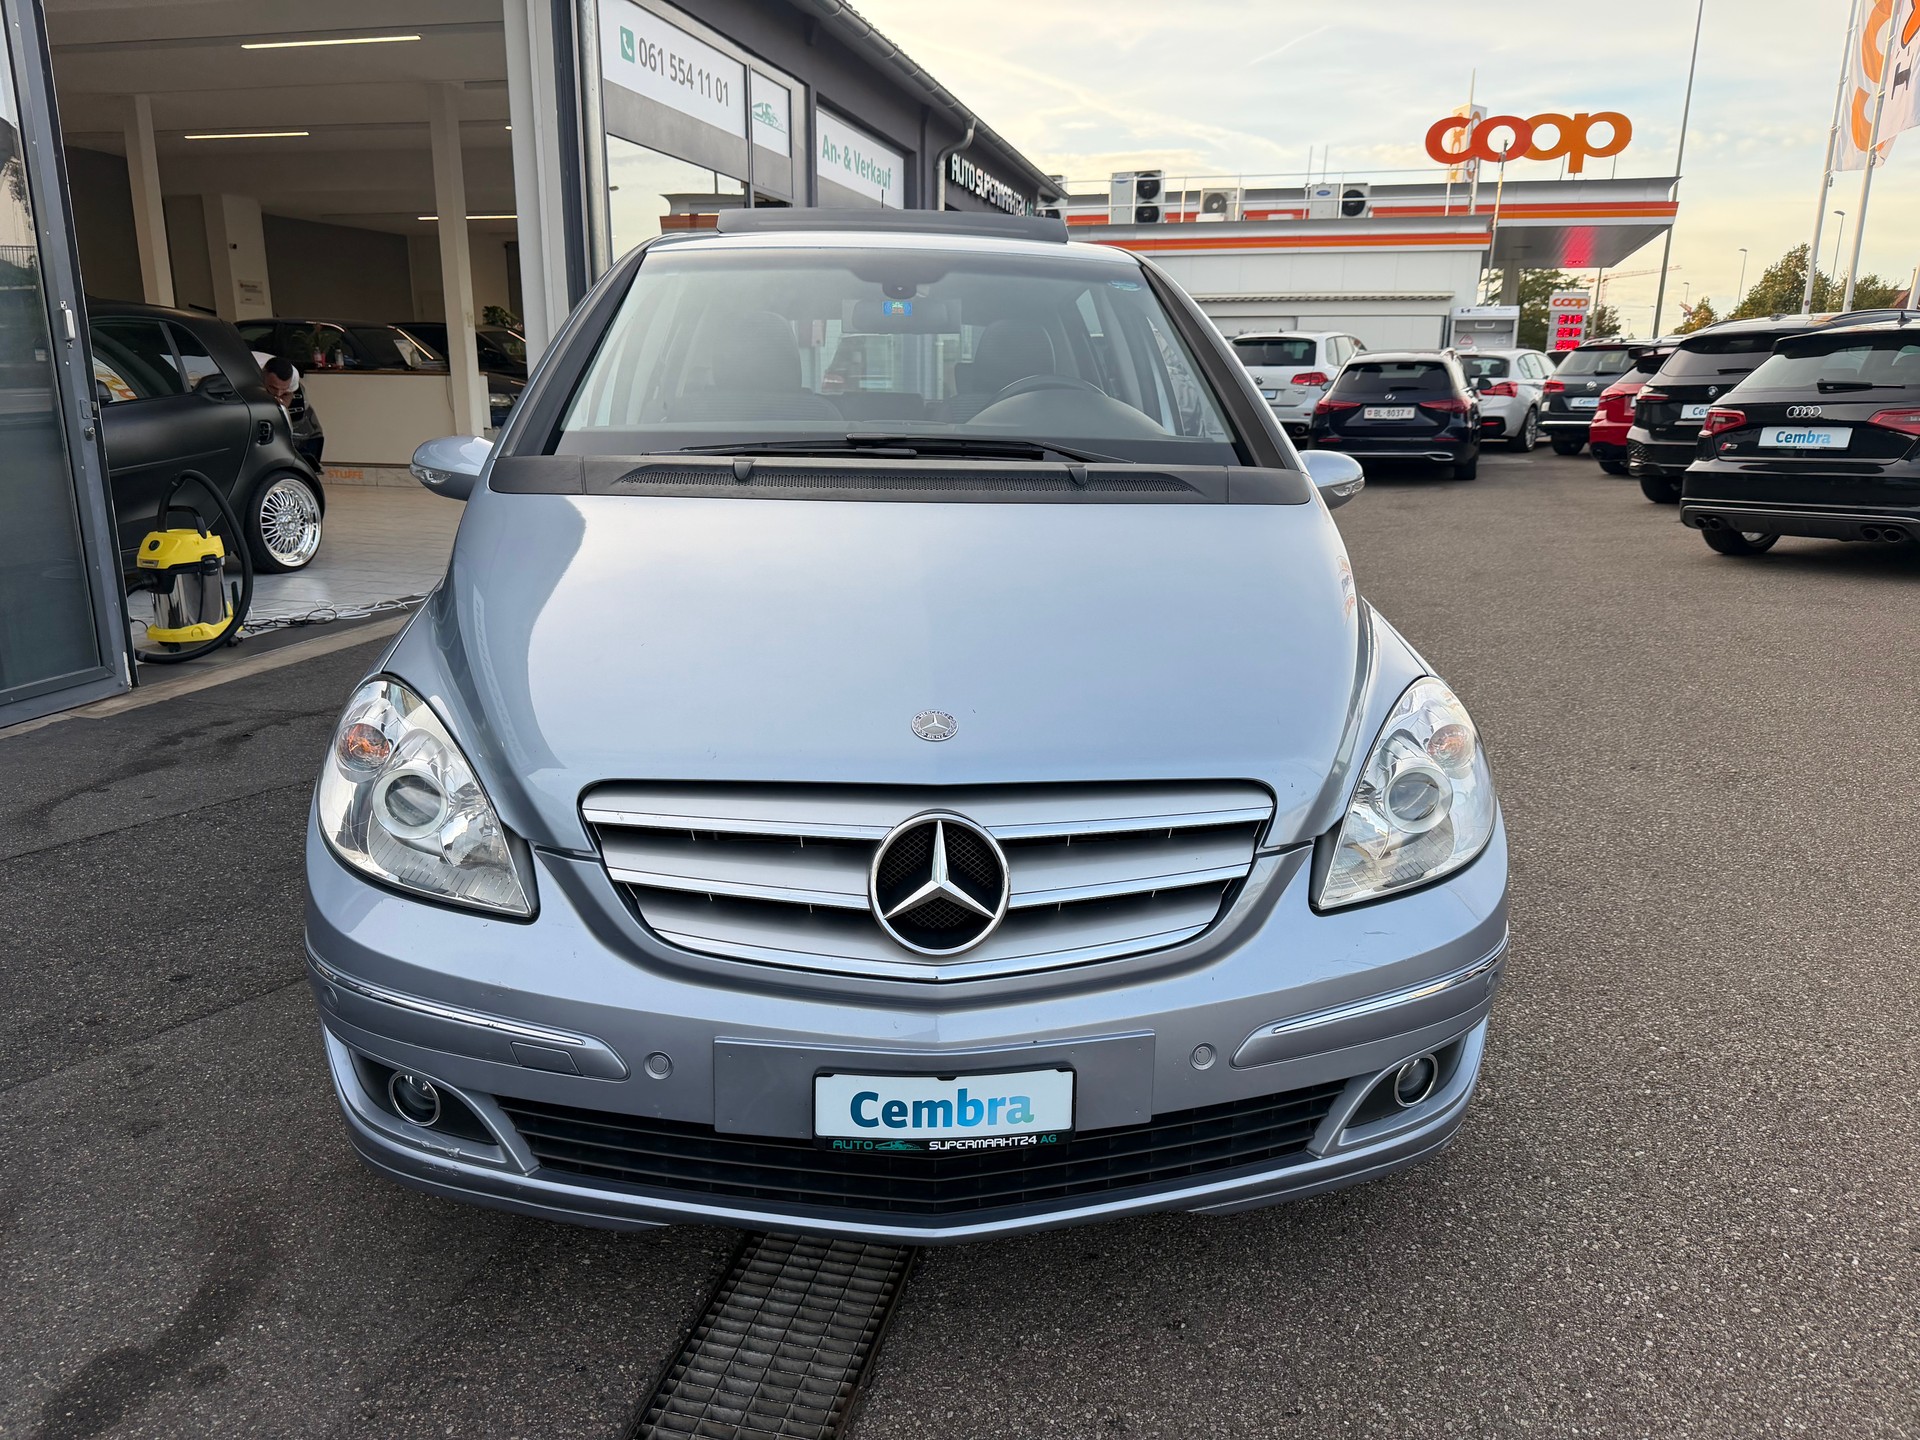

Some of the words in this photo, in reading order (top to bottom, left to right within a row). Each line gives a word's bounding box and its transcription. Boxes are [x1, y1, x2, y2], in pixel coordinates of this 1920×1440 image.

[638, 37, 665, 76] 061
[669, 52, 694, 90] 554
[697, 68, 711, 99] 11
[715, 77, 729, 107] 01
[1425, 111, 1633, 174] coop
[843, 148, 852, 170] &
[853, 150, 892, 190] Verkauf
[951, 152, 975, 191] AUTO
[1552, 297, 1588, 309] coop
[1775, 430, 1832, 445] Cembra
[850, 1088, 1035, 1128] Cembra
[833, 1140, 873, 1150] AUTO
[1040, 1134, 1057, 1144] AG
